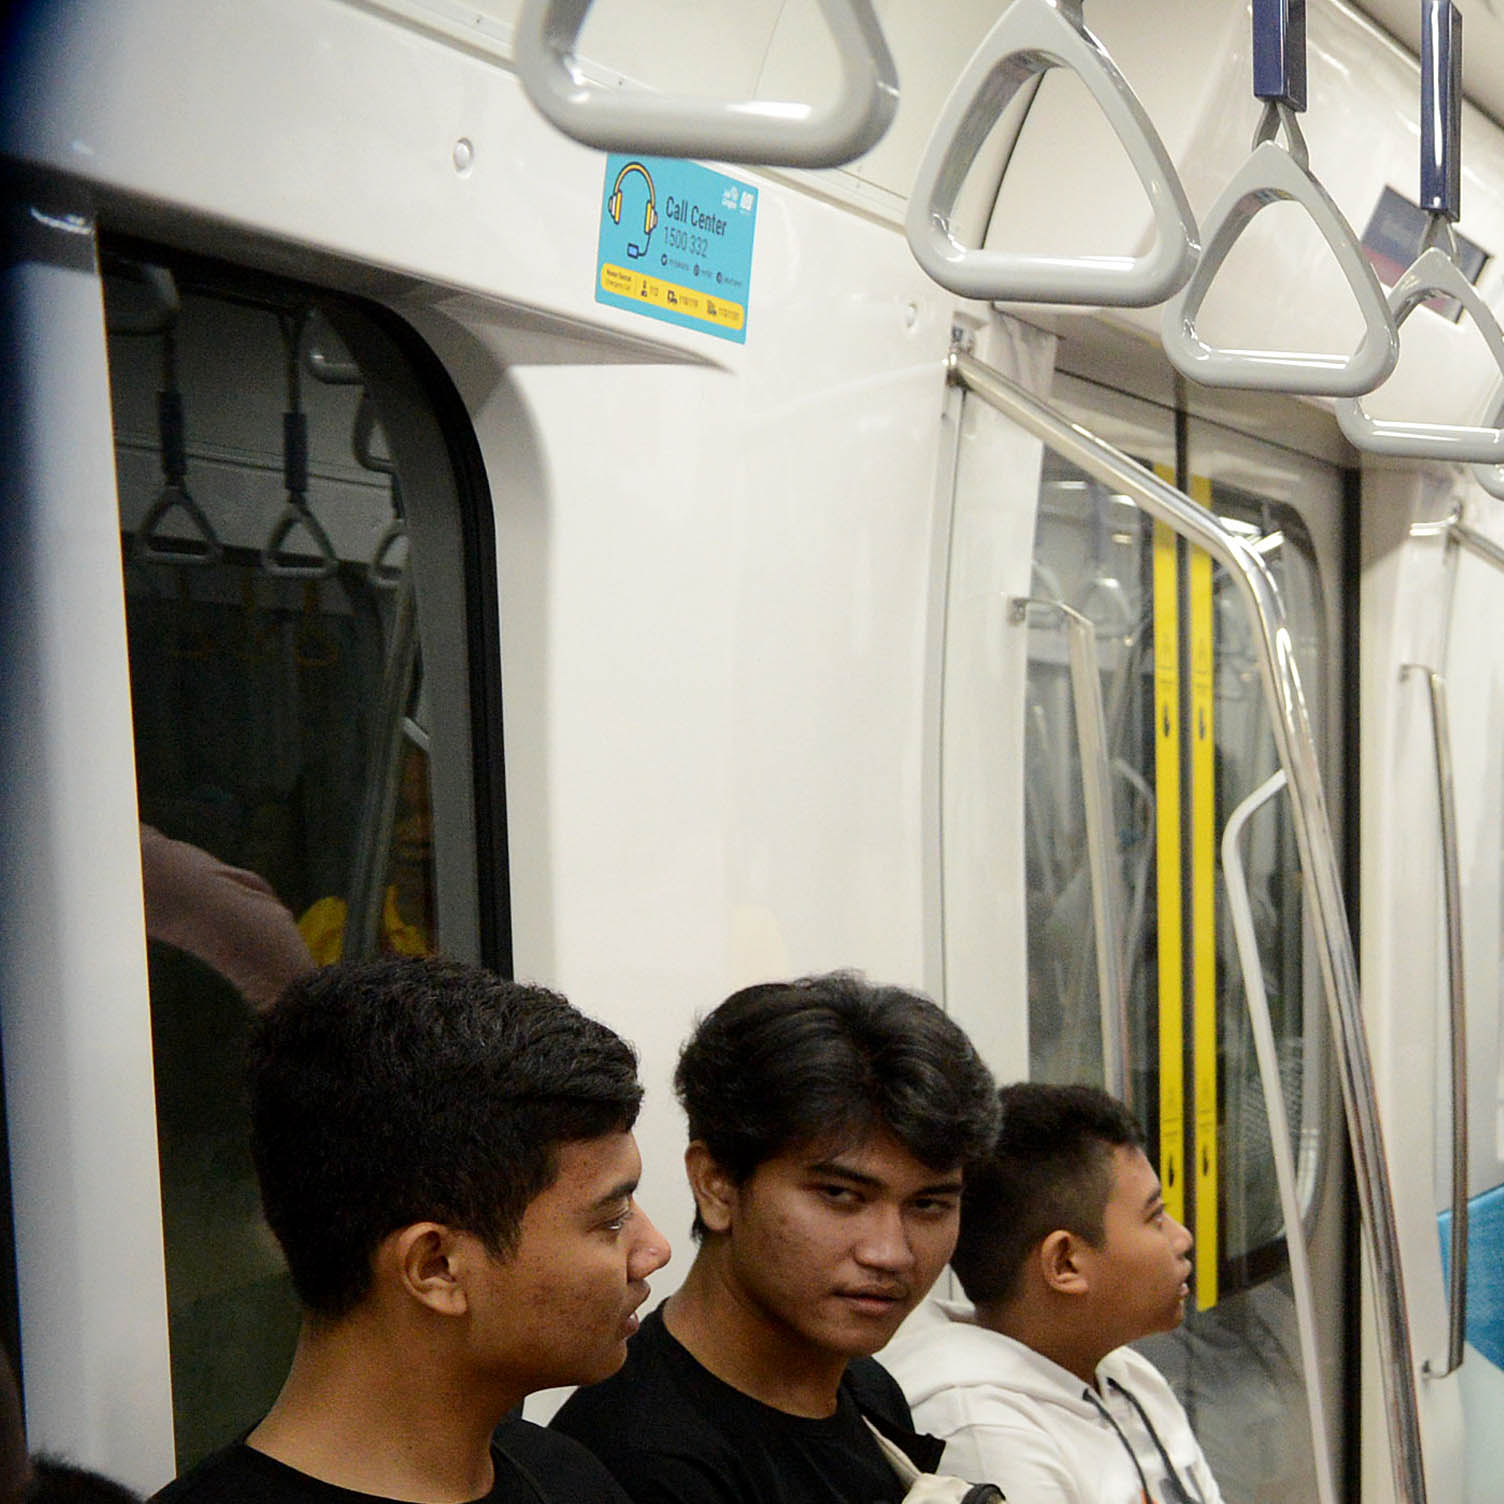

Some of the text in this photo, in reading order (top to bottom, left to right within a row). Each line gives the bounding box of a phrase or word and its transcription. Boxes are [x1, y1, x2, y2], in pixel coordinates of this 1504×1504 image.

[666, 196, 689, 225] Call
[690, 204, 728, 236] Center
[664, 226, 709, 258] 1500 332
